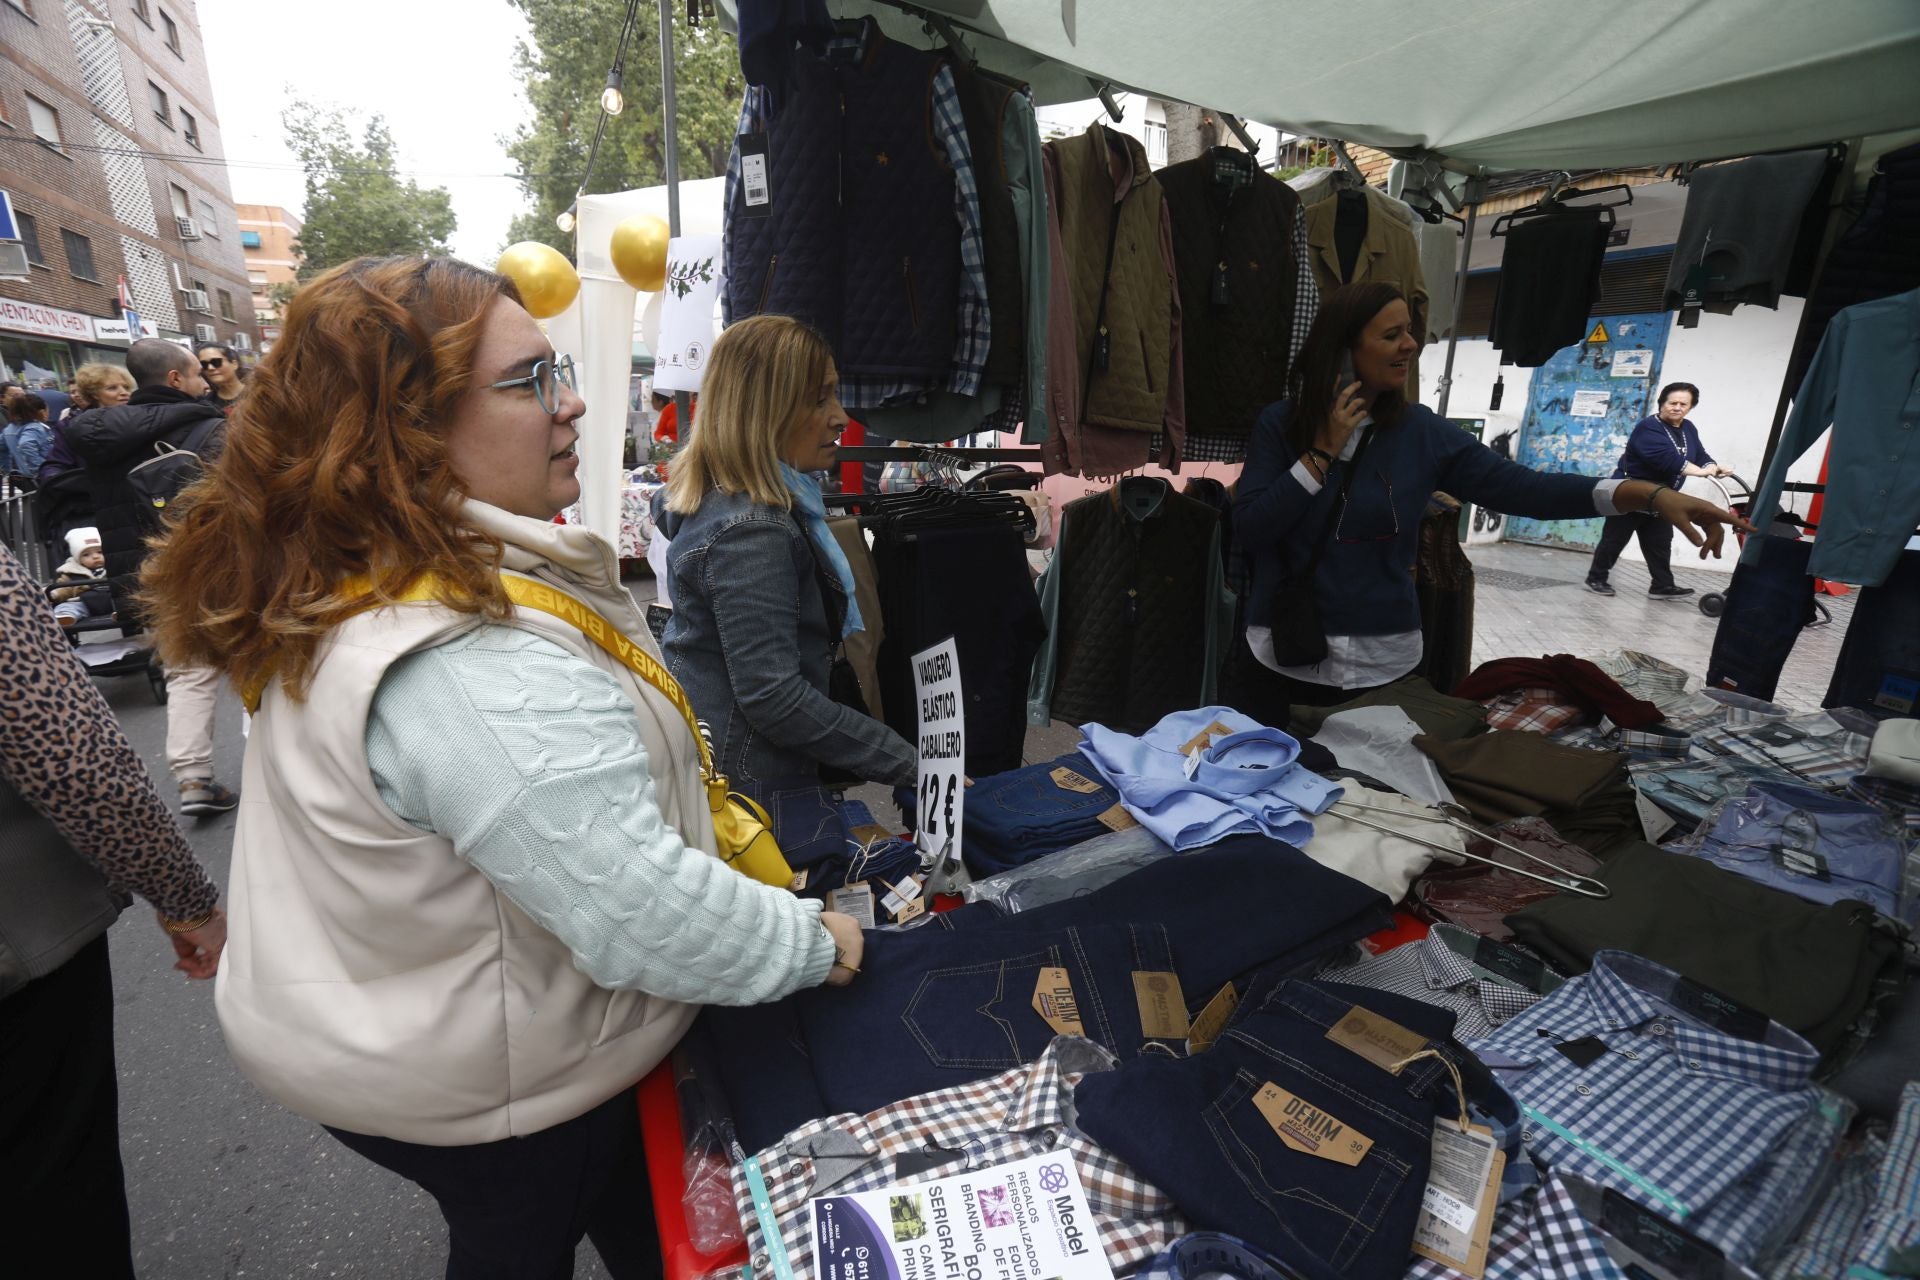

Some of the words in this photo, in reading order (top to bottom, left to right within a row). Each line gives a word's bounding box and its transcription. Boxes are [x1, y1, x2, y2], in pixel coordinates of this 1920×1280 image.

[918, 651, 952, 686] VAQUERO
[923, 691, 956, 723] ELÁSTICO
[921, 730, 961, 759] CABALLERO
[920, 773, 940, 835] 12
[944, 773, 957, 839] €
[1053, 988, 1080, 1022] DENIM
[1265, 1090, 1277, 1099] 44
[1283, 1098, 1343, 1142] DENIM
[1351, 1141, 1363, 1152] 30
[1018, 1171, 1040, 1224] REGALOS
[928, 1186, 965, 1279] SERIGRAFÍ
[961, 1184, 987, 1253] BRANDING
[1005, 1174, 1041, 1276] PERSONALIZADOS
[1047, 1199, 1060, 1230] Espacio
[1055, 1228, 1069, 1258] Creativo
[1055, 1194, 1088, 1257] Medel
[858, 1261, 869, 1280] 611
[993, 1248, 1007, 1266] DE
